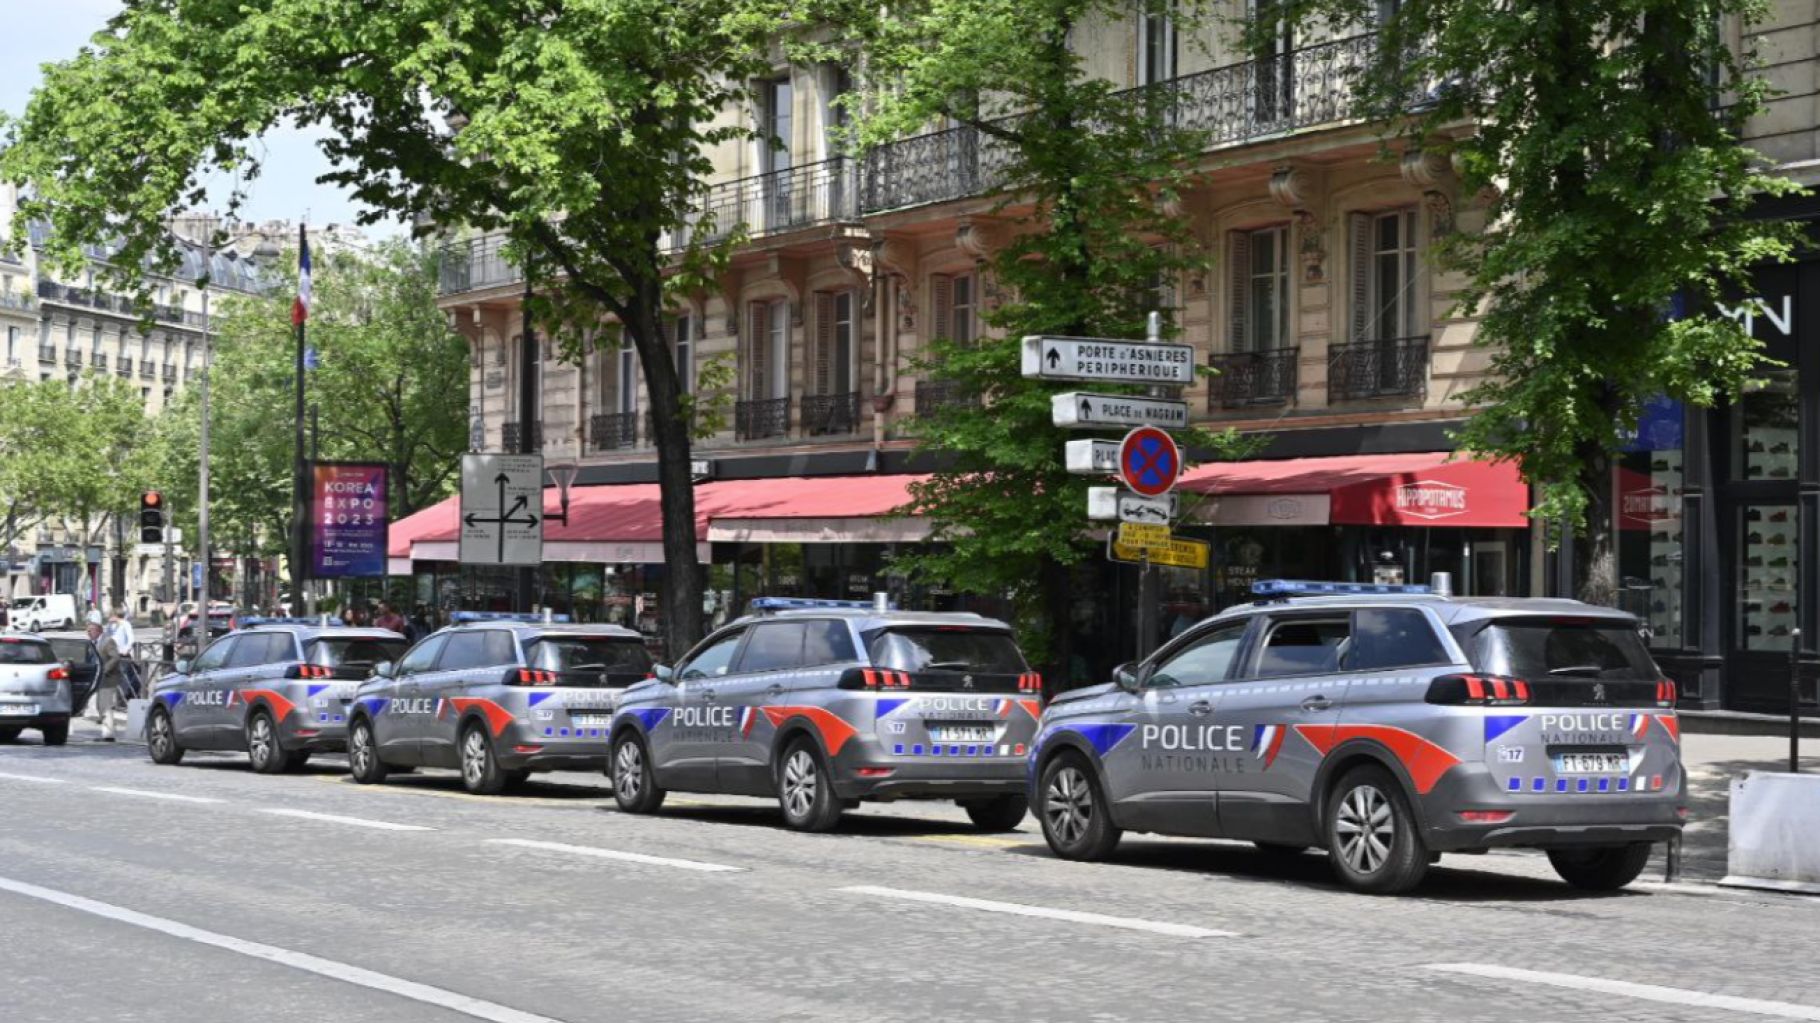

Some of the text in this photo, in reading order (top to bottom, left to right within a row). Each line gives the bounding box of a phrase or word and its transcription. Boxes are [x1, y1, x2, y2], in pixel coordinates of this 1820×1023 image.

[1077, 345, 1115, 360] PORTE
[1077, 361, 1180, 378] PERIPHERIQUE
[1102, 403, 1131, 418] PLACE
[324, 481, 375, 494] KOREA
[324, 496, 374, 510] EXPO
[1395, 487, 1466, 509] HIPPOPOTAMUS
[324, 512, 374, 525] 2023
[187, 689, 223, 706] POLICE
[918, 698, 989, 711] POLICE
[391, 698, 432, 714] POLICE
[673, 706, 734, 727] POLICE
[1540, 713, 1624, 731] POLICE
[1142, 723, 1245, 751] POLICE
[1540, 733, 1623, 744] NATIONALE
[1508, 750, 1522, 760] 17
[1141, 755, 1246, 774] NATIONALE
